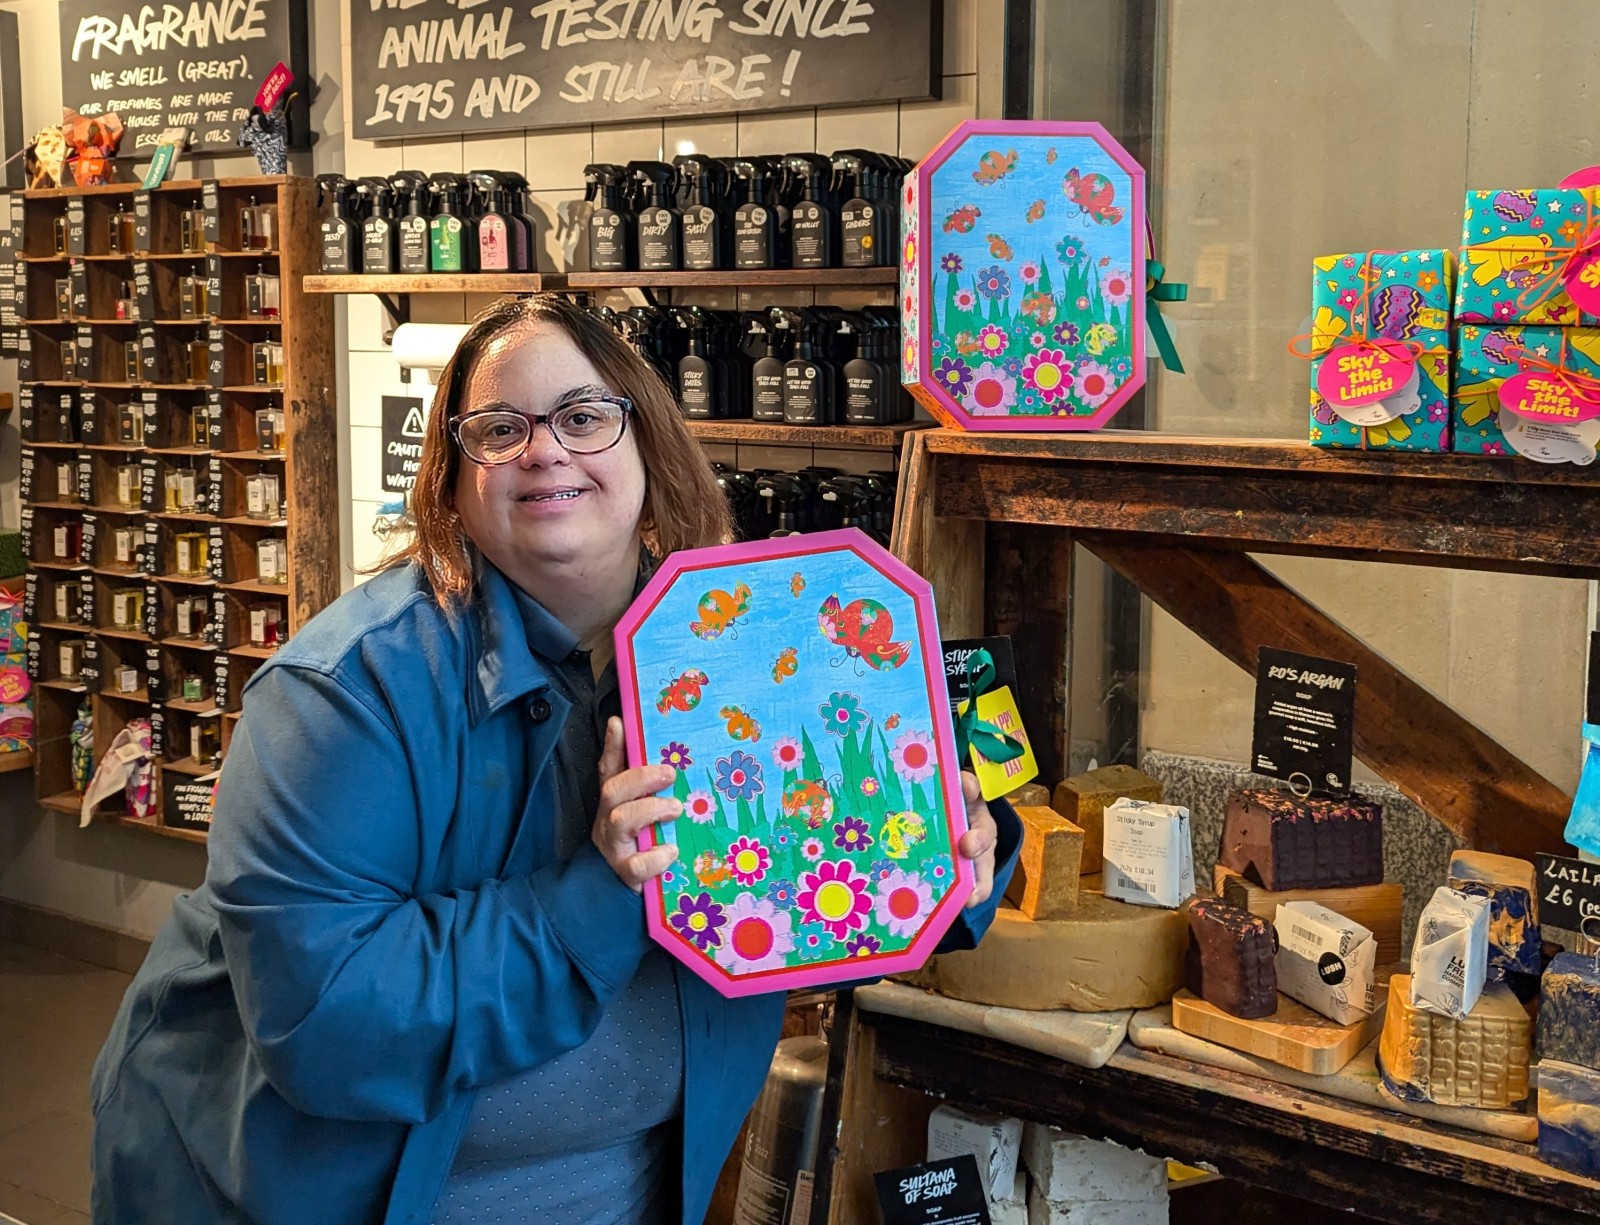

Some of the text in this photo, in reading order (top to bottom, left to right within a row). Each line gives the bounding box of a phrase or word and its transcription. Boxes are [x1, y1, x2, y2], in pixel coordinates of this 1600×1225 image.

[72, 0, 266, 62] FRAGRANCE
[378, 0, 874, 69] ANIMAL TESTING SINCE
[91, 54, 253, 90] WE SMELL (GREAT).
[365, 80, 454, 127] 1995
[464, 74, 541, 119] AND
[559, 58, 662, 104] STILL
[80, 91, 233, 115] OUR PERFUMES ARE MADE
[168, 112, 199, 127] WITH
[204, 110, 230, 123] THE
[232, 108, 250, 121] FIN
[204, 129, 231, 143] OILS
[597, 226, 615, 239] BIG
[642, 225, 669, 236] DIRTY
[685, 223, 709, 234] SALTY
[1338, 350, 1390, 372] Sky's
[684, 371, 703, 379] STICKY
[1348, 368, 1383, 384] the
[1340, 377, 1393, 400] Limit!
[1534, 392, 1571, 406] the
[1519, 399, 1580, 417] Limit!
[387, 441, 423, 458] CAUTI
[386, 473, 415, 488] WAT
[1268, 666, 1345, 690] RO'S ARGAN
[187, 785, 212, 794] FRAGRA
[1117, 816, 1155, 827] Sticky Syrup
[1130, 828, 1144, 836] Soap
[1544, 884, 1573, 906] £6
[1320, 961, 1343, 976] LUSH
[1450, 956, 1465, 969] LU
[1444, 969, 1465, 984] HANDM
[1446, 963, 1465, 978] FRE
[1366, 983, 1375, 992] LU
[1441, 974, 1465, 990] COSMET
[899, 1167, 956, 1192] SULTANA
[905, 1181, 958, 1204] OF SOAP
[926, 1206, 942, 1214] SOAP
